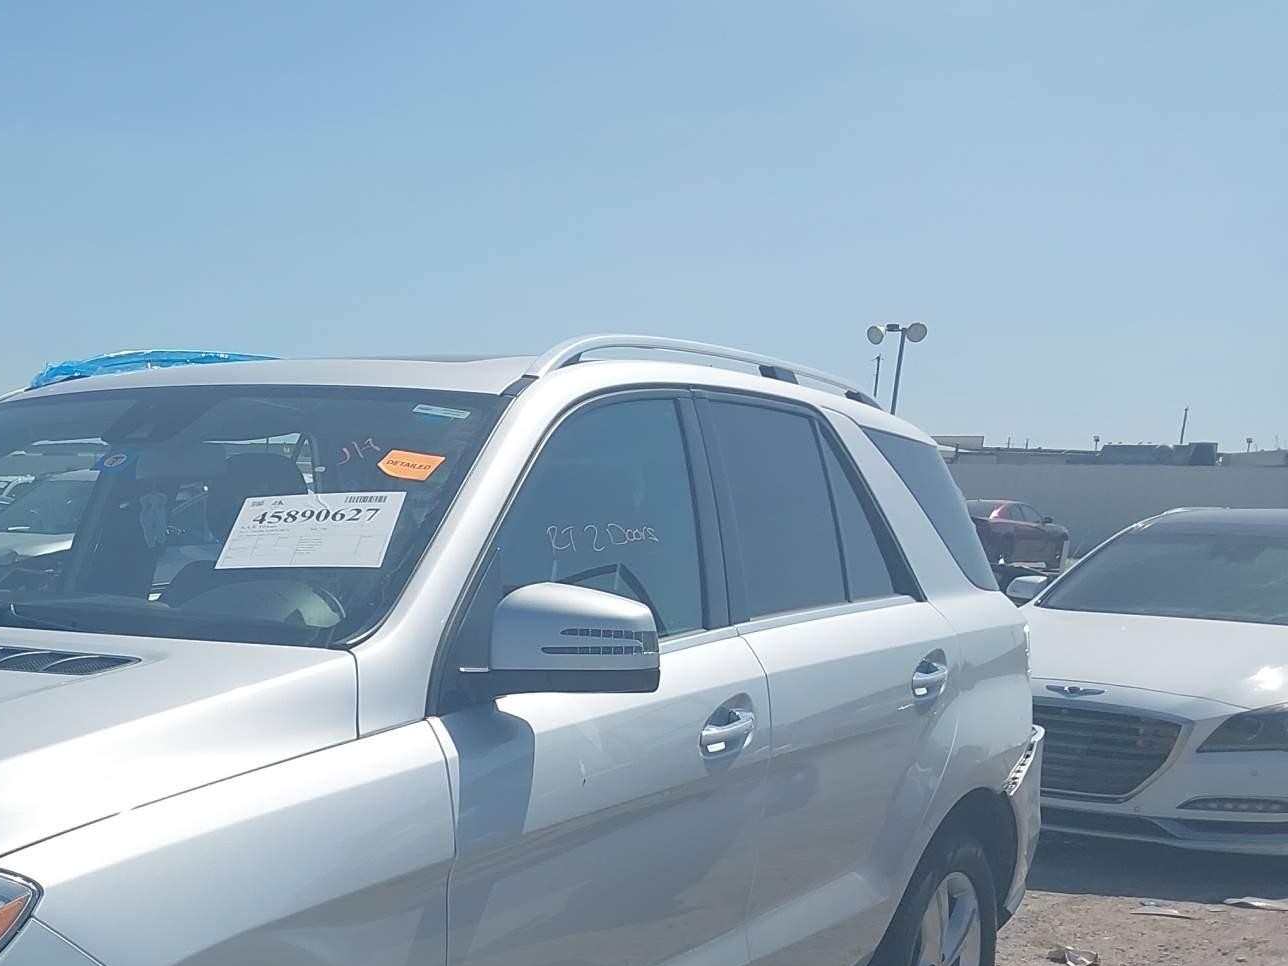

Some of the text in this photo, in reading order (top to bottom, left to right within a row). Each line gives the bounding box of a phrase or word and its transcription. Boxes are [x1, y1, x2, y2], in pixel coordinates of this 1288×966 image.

[386, 459, 431, 470] DETAILED
[252, 508, 381, 525] 45890627
[583, 524, 606, 552] 2
